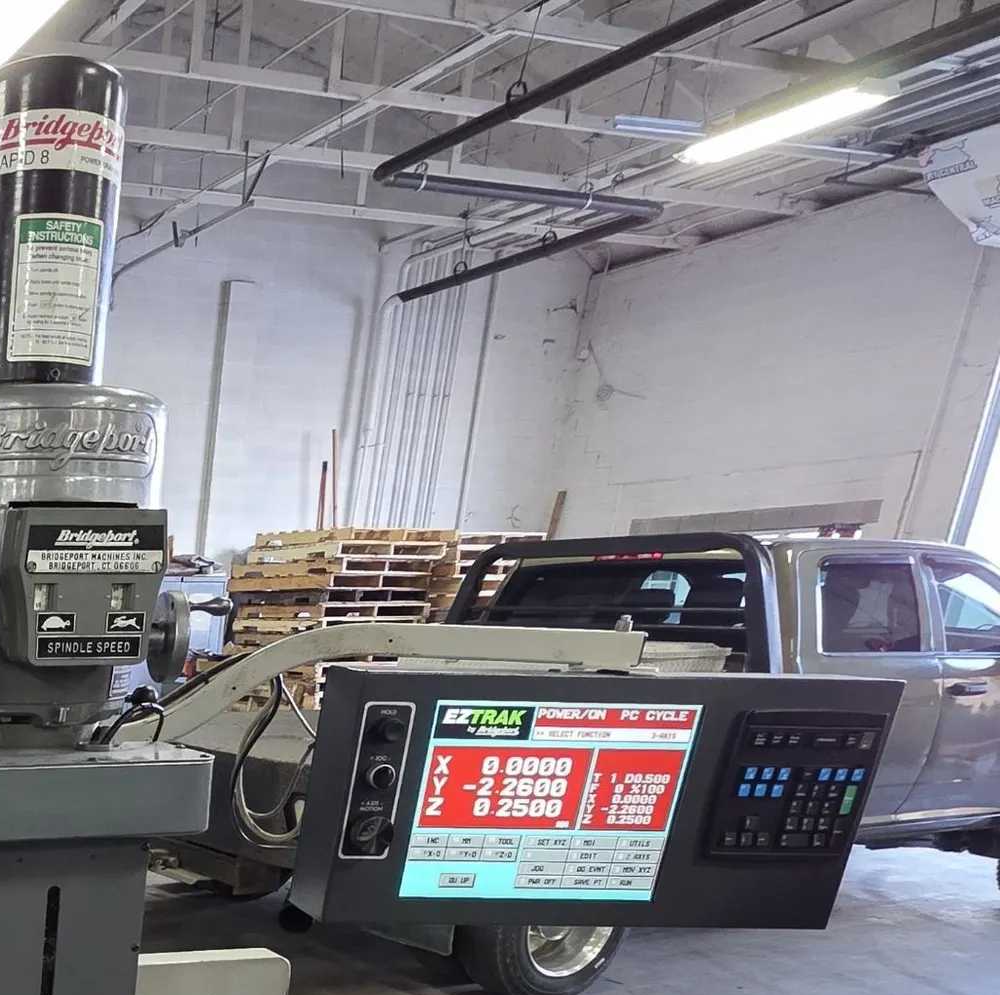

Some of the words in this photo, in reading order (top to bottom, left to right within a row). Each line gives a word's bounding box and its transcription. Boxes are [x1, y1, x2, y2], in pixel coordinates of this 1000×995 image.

[0, 113, 119, 153] Bridgepo
[40, 149, 49, 164] 8
[46, 220, 81, 232] SAFETY
[28, 230, 94, 246] INSTRUCTIONS
[55, 529, 138, 550] Bridgeport
[41, 552, 88, 561] BRIDGEPORT
[91, 552, 130, 561] MACHINES
[47, 642, 93, 654] SPINDLE
[96, 640, 131, 653] SPEED
[442, 708, 527, 725] EZTRAK
[538, 708, 608, 720] POWER/ON
[620, 710, 639, 721] PC
[645, 710, 689, 721] CYCLE
[434, 755, 453, 774] X
[481, 756, 572, 776] 0.0000
[594, 773, 602, 782] T
[611, 773, 617, 783] 1
[624, 773, 671, 784] D0.500
[432, 776, 448, 796] Y
[462, 777, 568, 797] -2.2600
[611, 794, 657, 804] 0.0000
[425, 797, 444, 816] Z
[472, 798, 563, 817] 0.2500
[586, 804, 595, 813] Y
[600, 805, 654, 814] -2.2600
[582, 814, 593, 824] Z
[606, 815, 652, 825] 0.2500
